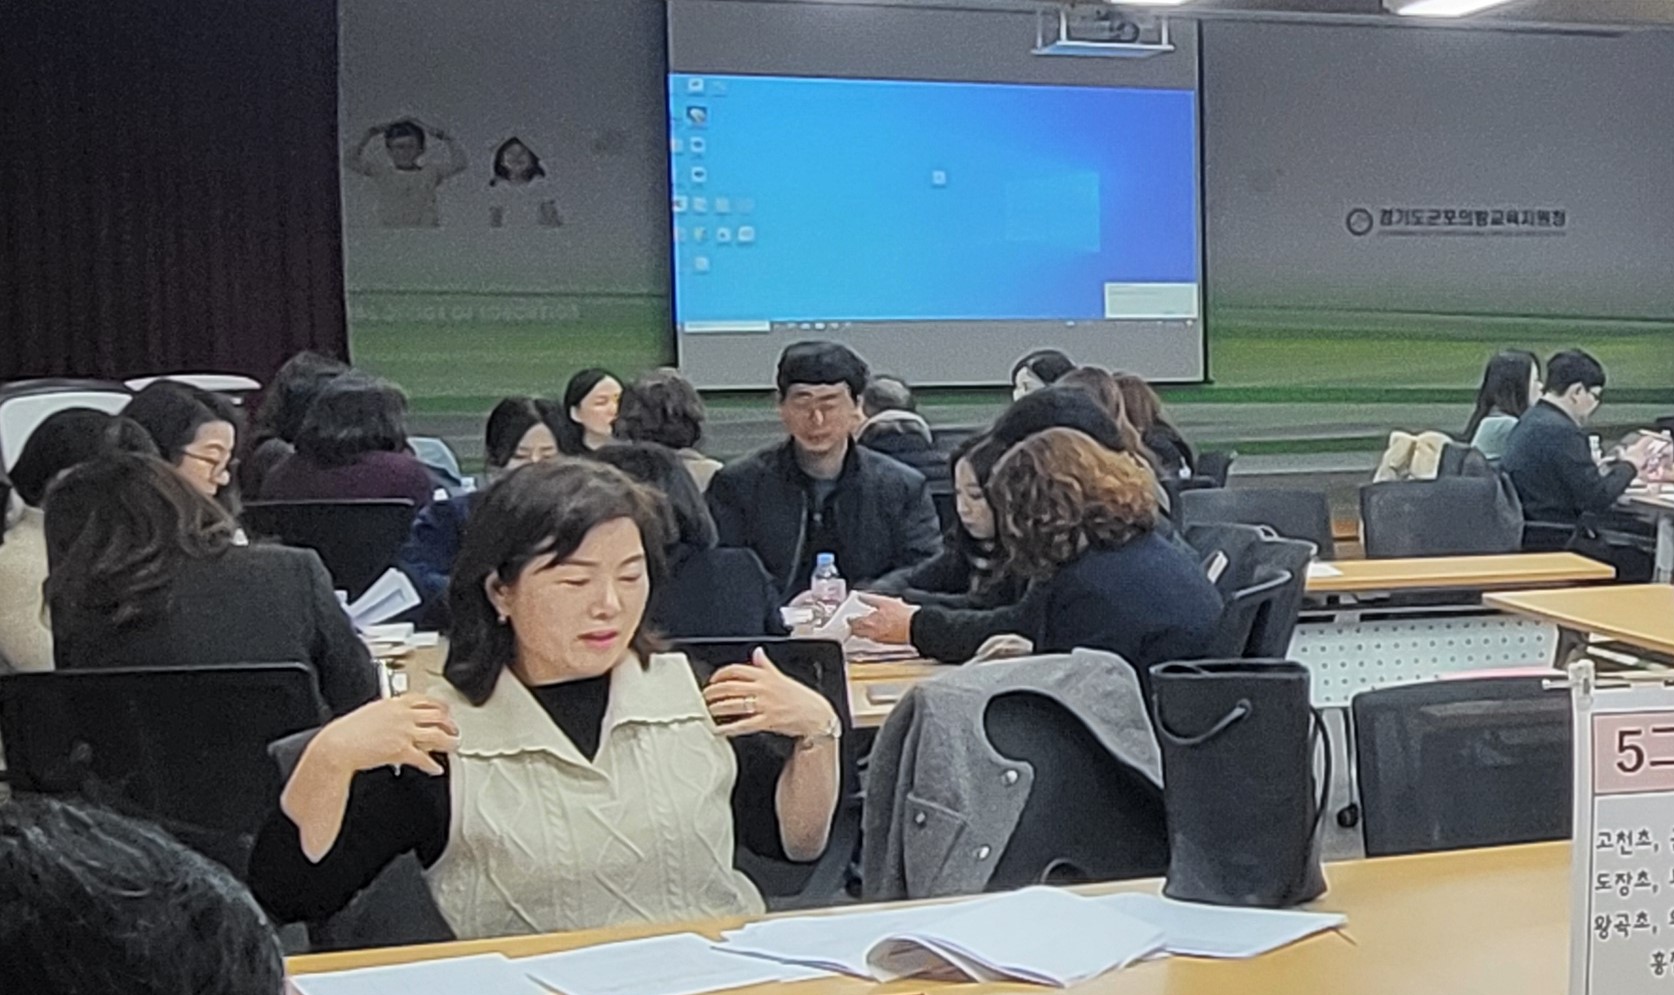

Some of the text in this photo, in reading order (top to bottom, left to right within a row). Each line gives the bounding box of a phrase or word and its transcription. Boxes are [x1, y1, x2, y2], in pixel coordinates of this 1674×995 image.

[1596, 828, 1659, 855] 고천초,
[1595, 870, 1659, 897] 도장초,
[1594, 910, 1658, 940] 왕곡초,
